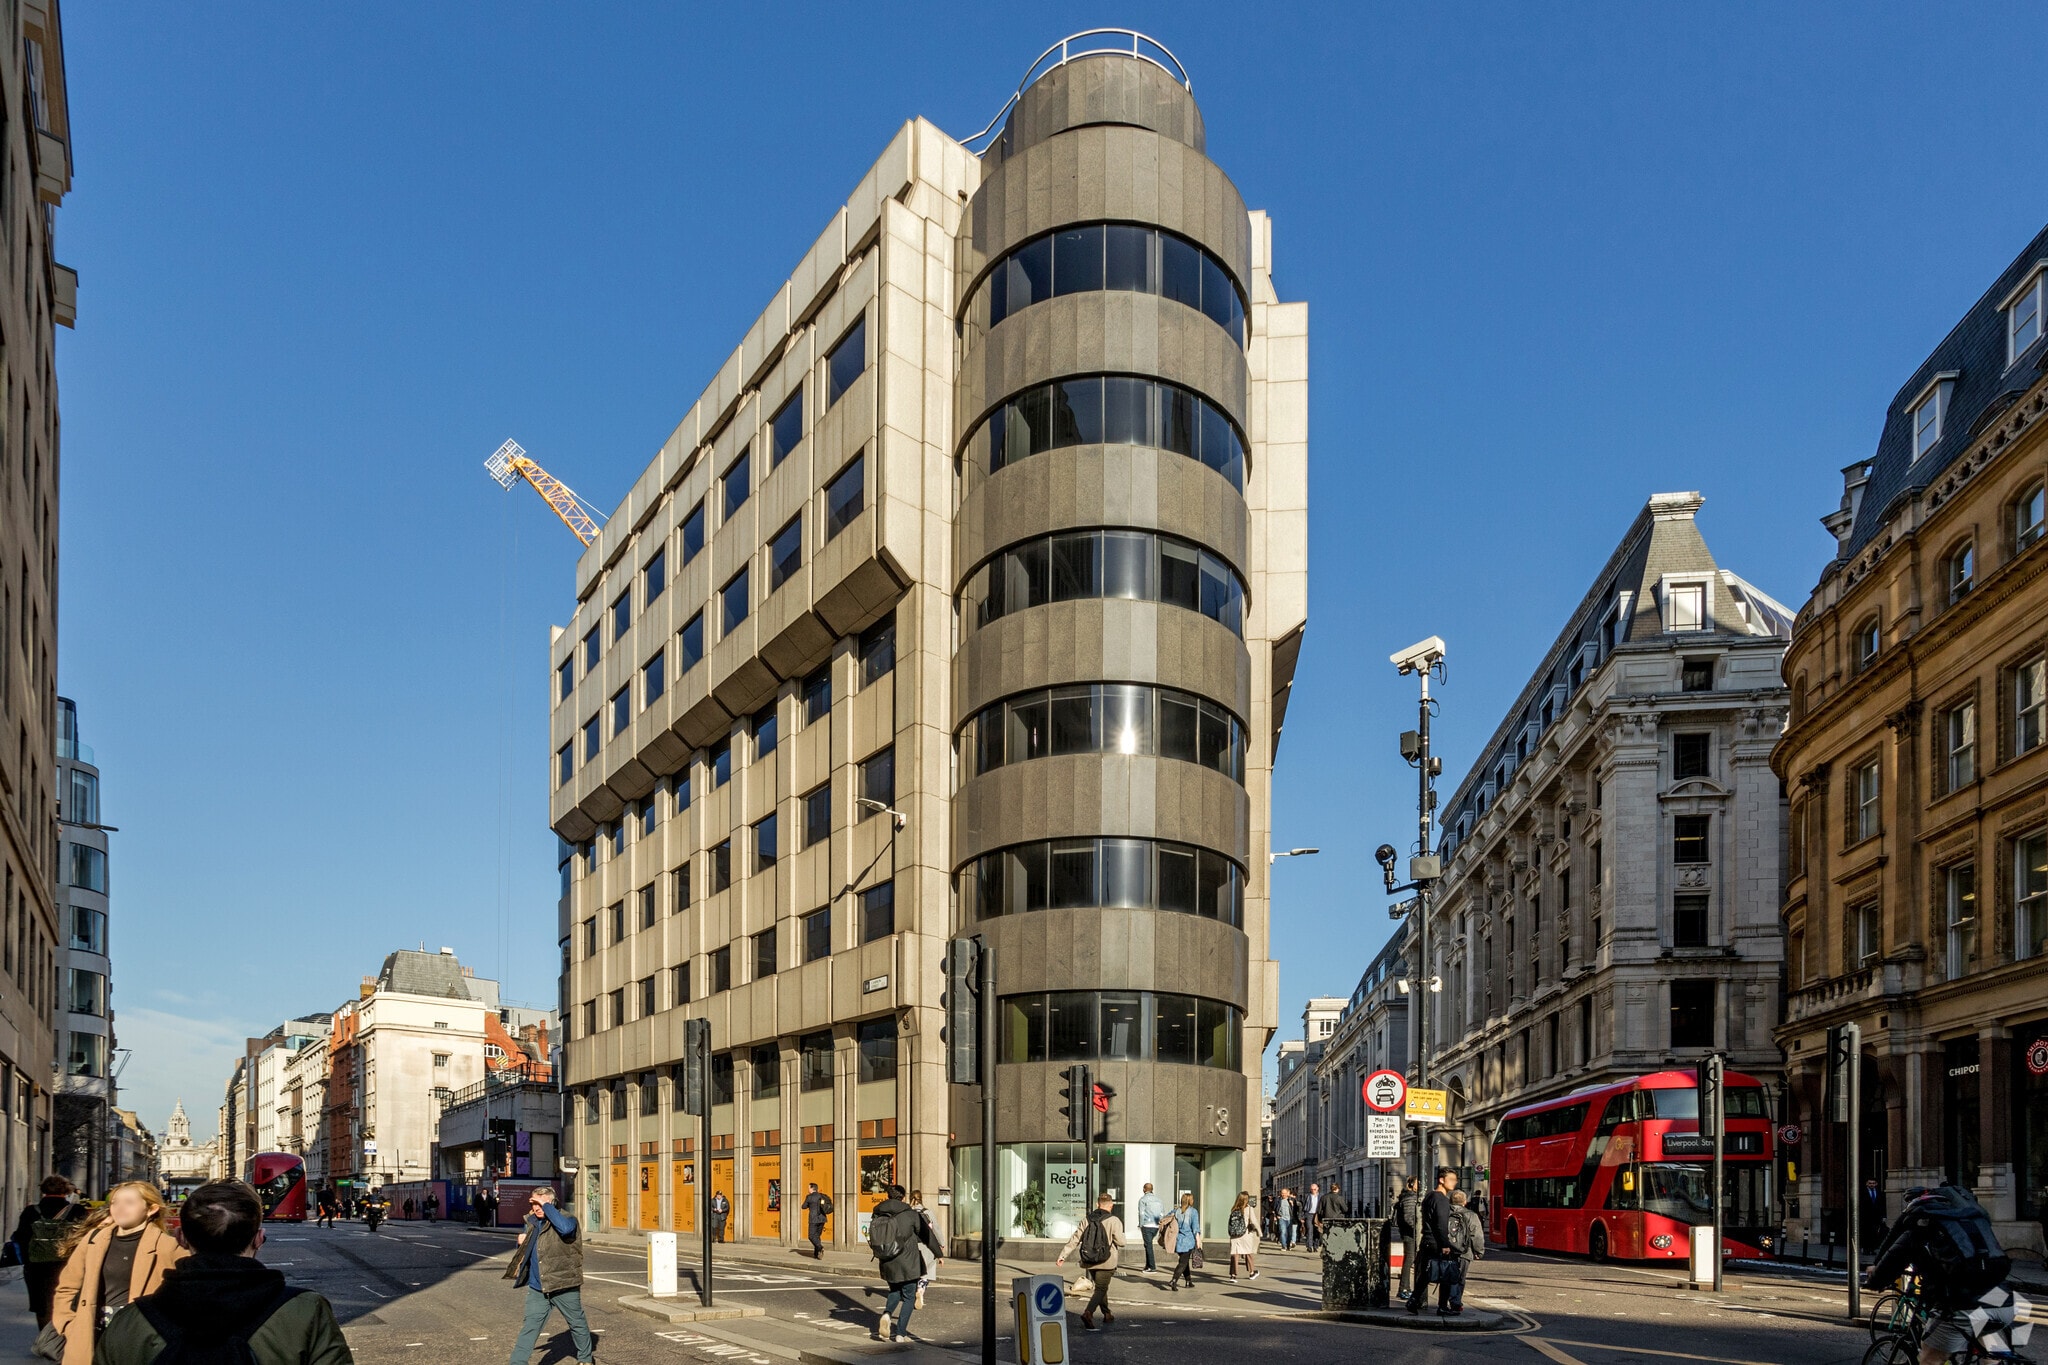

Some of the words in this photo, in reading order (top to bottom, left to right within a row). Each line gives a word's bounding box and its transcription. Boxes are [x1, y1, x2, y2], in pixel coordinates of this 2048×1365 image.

[1206, 1104, 1230, 1136] 18
[1667, 1139, 1700, 1149] Liverpool
[1739, 1137, 1749, 1150] 11
[964, 1181, 979, 1202] 18
